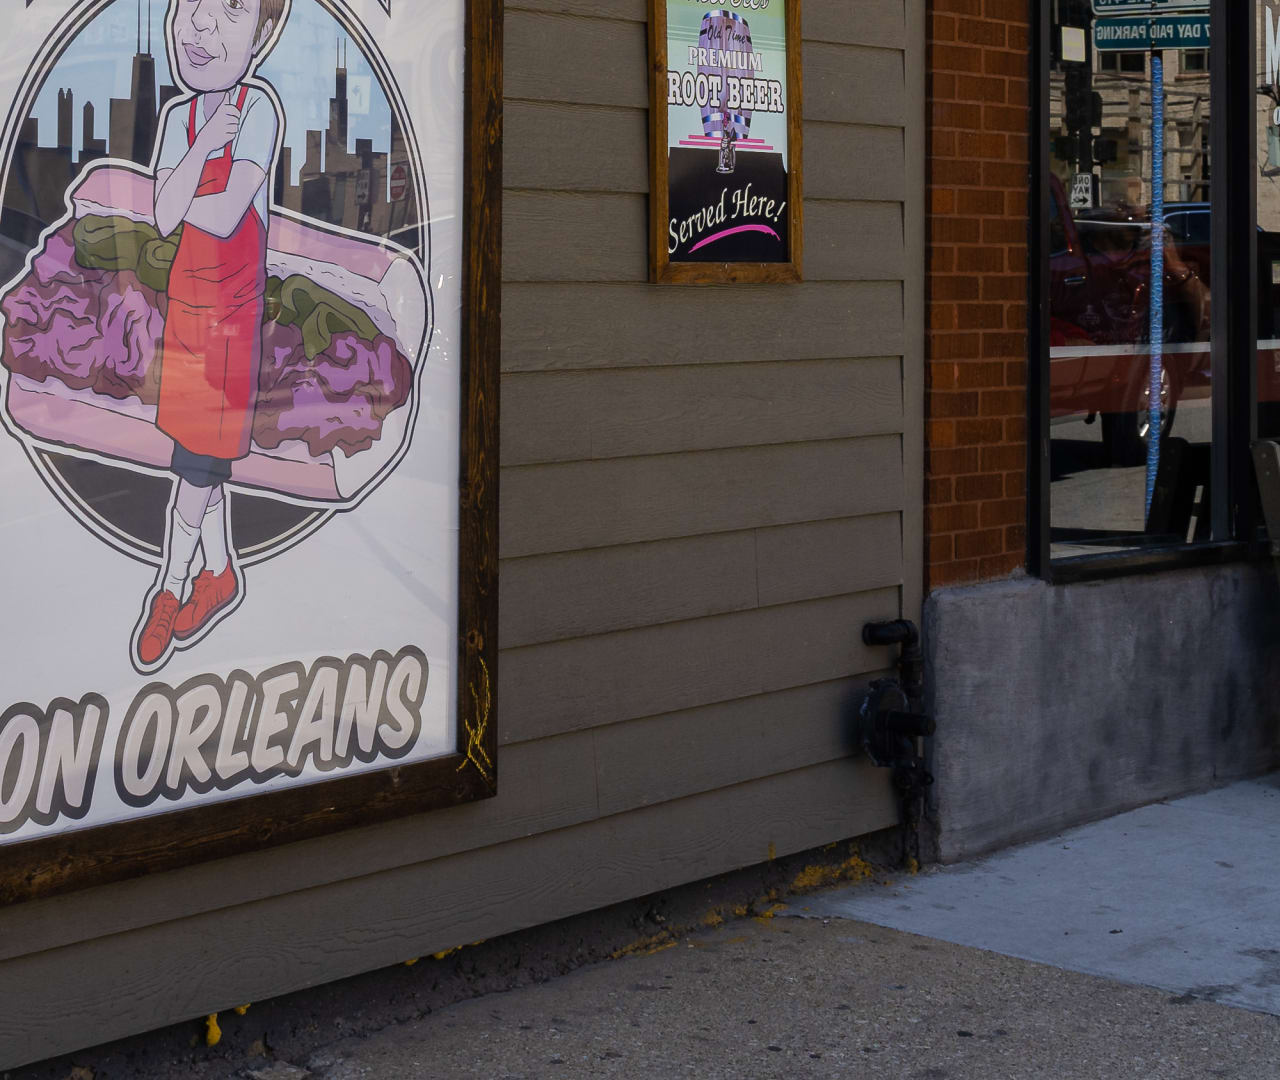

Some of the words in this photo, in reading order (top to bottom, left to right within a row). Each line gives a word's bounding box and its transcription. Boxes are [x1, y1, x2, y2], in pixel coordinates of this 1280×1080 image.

[707, 24, 722, 41] Old
[726, 24, 746, 45] Time
[688, 45, 763, 72] PREMIUM
[667, 70, 722, 108] ROOT
[726, 75, 784, 113] BEER
[668, 187, 726, 255] Served
[731, 182, 787, 223] Here!
[114, 645, 429, 808] ORLEANS
